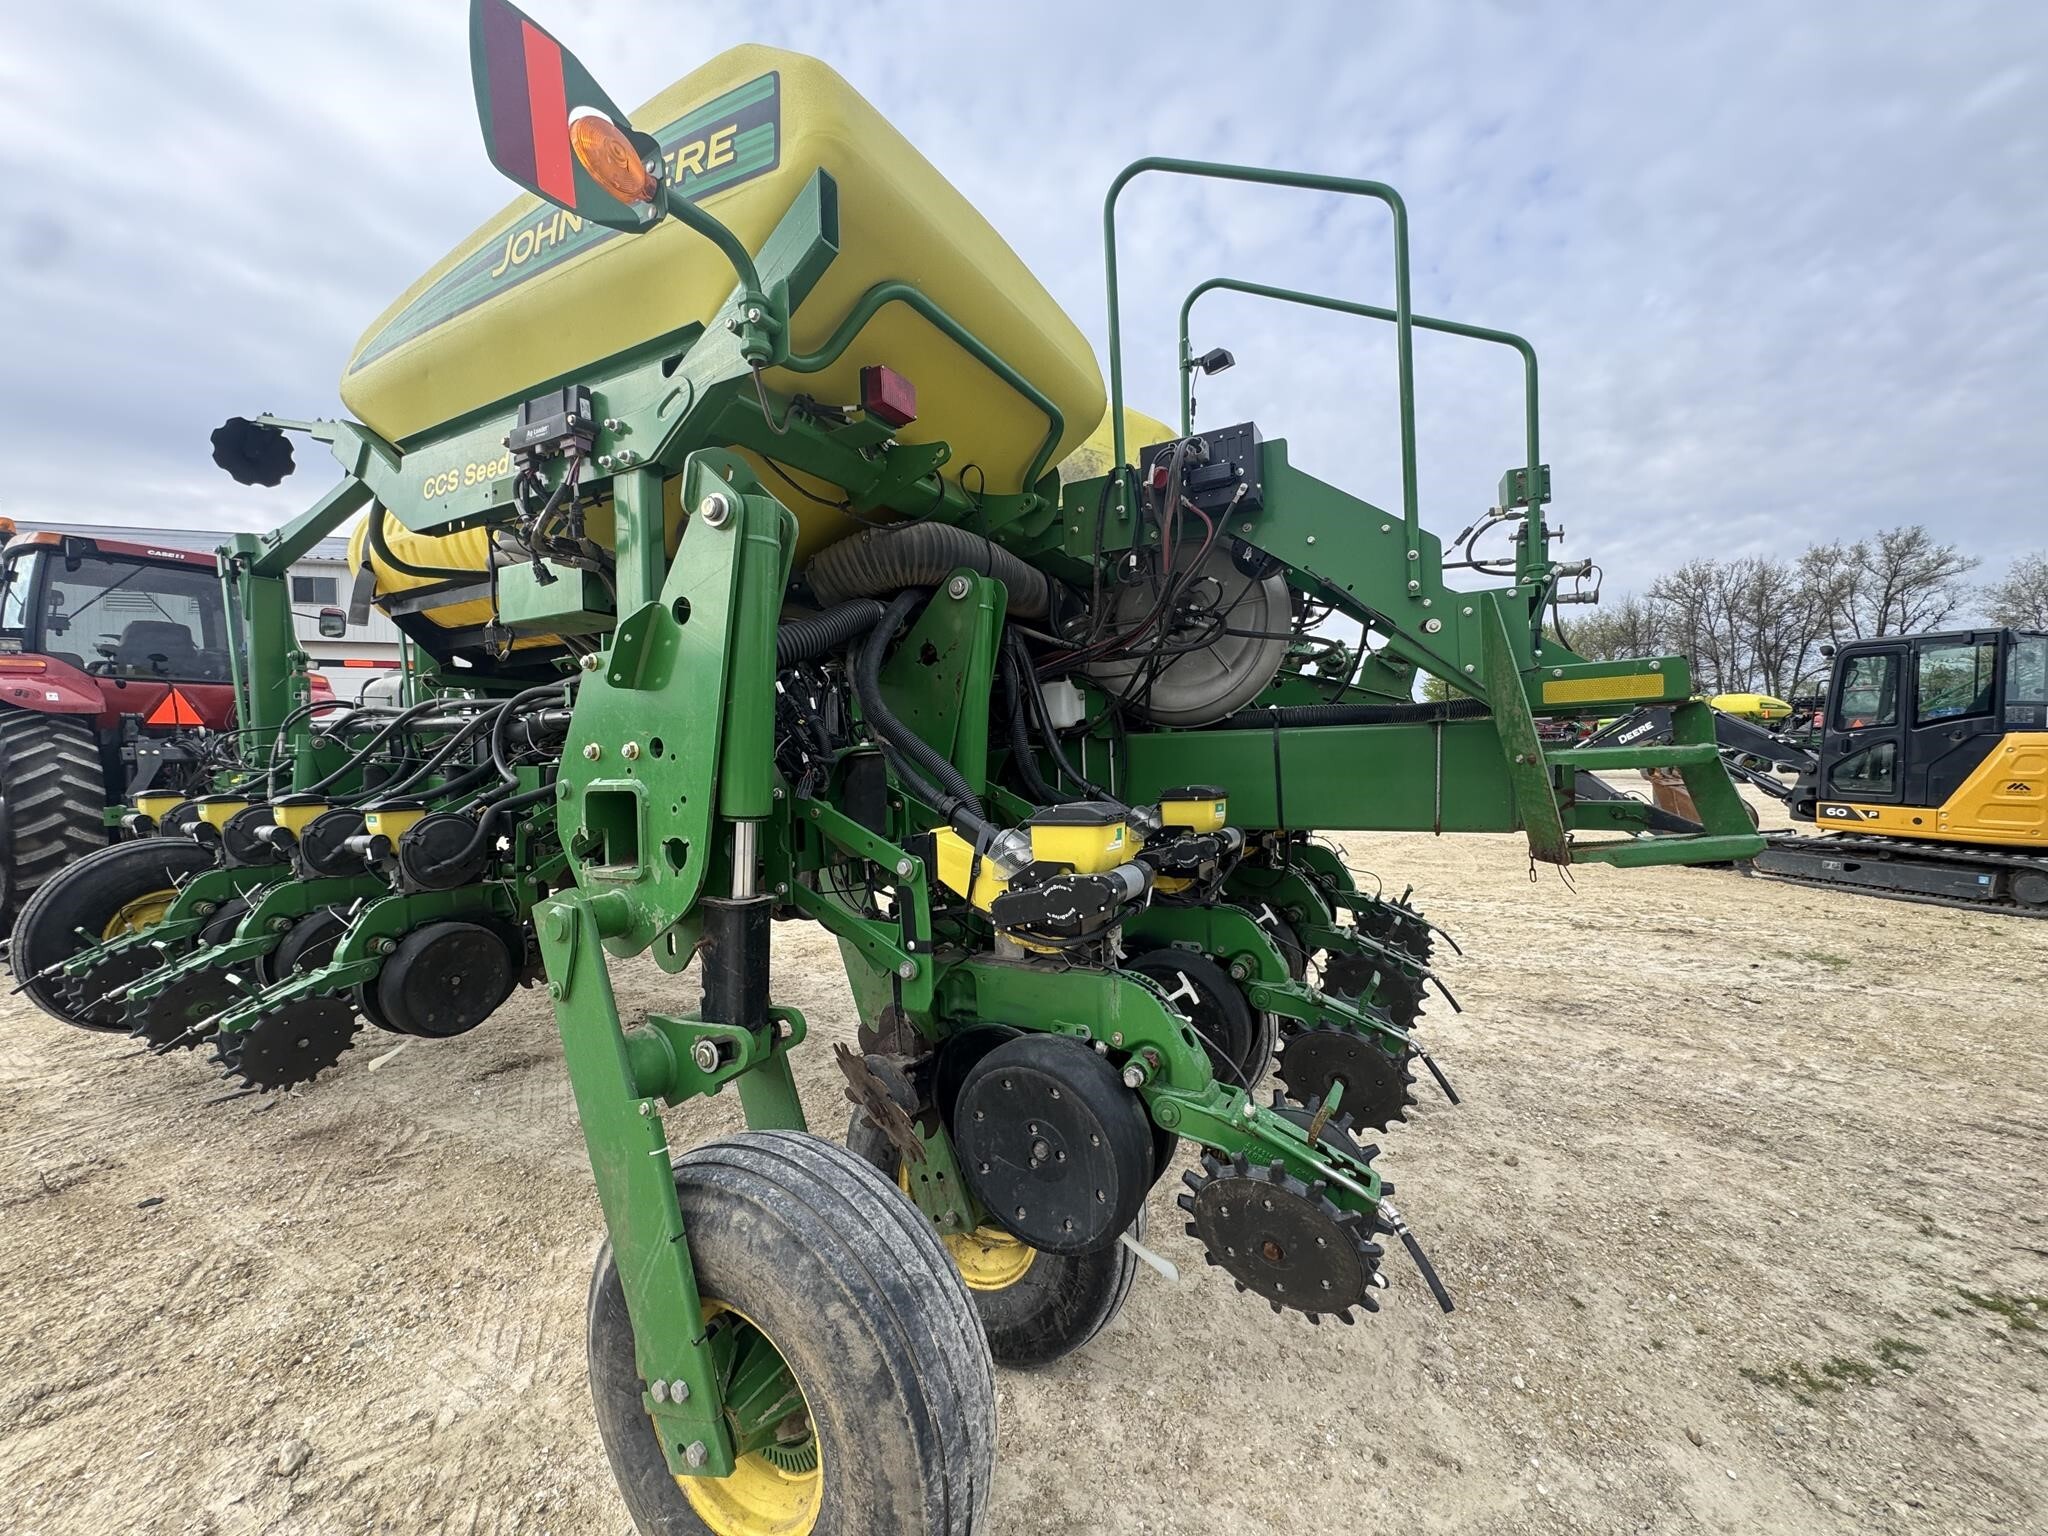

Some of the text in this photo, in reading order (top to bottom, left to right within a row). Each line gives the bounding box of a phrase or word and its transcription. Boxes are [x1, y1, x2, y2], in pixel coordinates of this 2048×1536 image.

[491, 210, 582, 278] JOHN
[423, 449, 510, 500] CCS Seed
[1617, 721, 1654, 744] DEERE
[1826, 807, 1847, 817] 60
